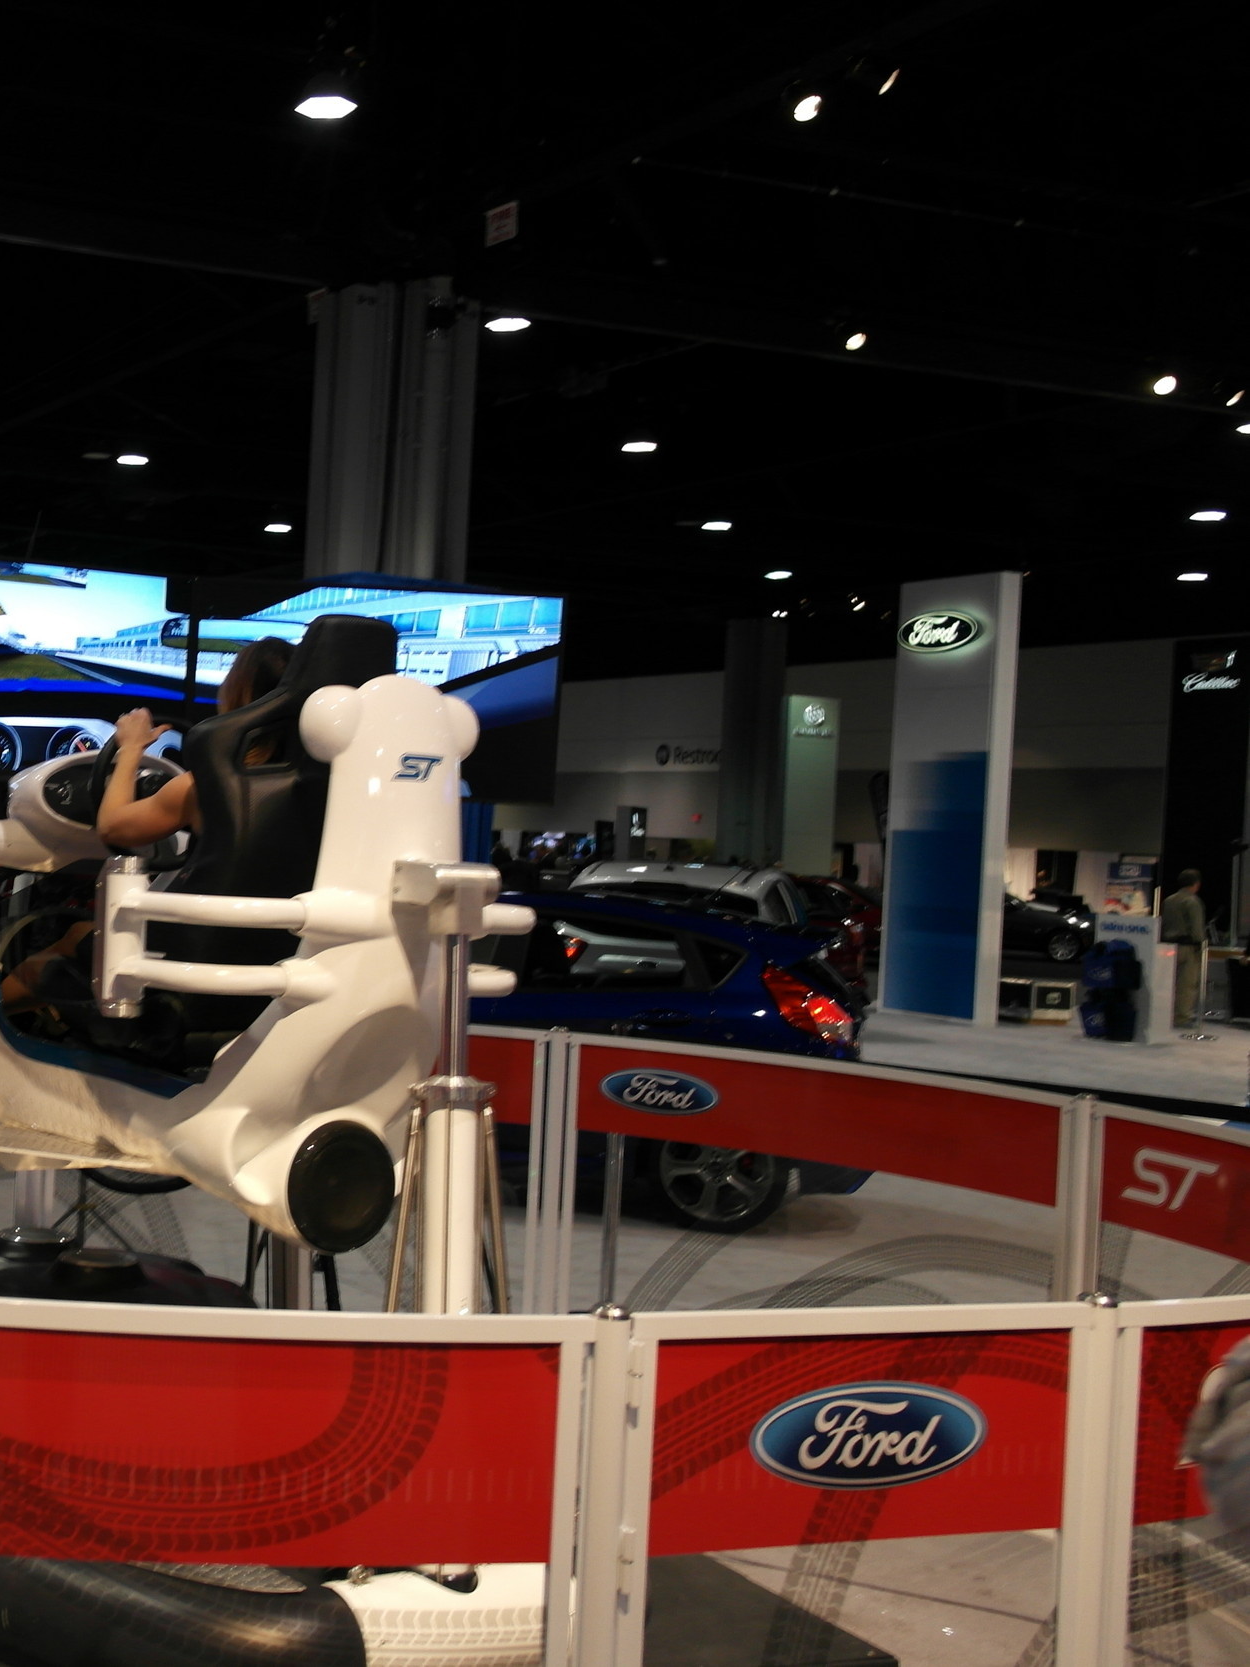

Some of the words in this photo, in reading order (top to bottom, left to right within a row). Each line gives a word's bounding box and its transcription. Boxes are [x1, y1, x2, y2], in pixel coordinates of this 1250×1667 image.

[908, 615, 961, 646] Ford
[390, 752, 444, 783] ST
[622, 1073, 697, 1110] Ford
[1120, 1146, 1221, 1213] ST
[798, 1399, 943, 1471] Ford
